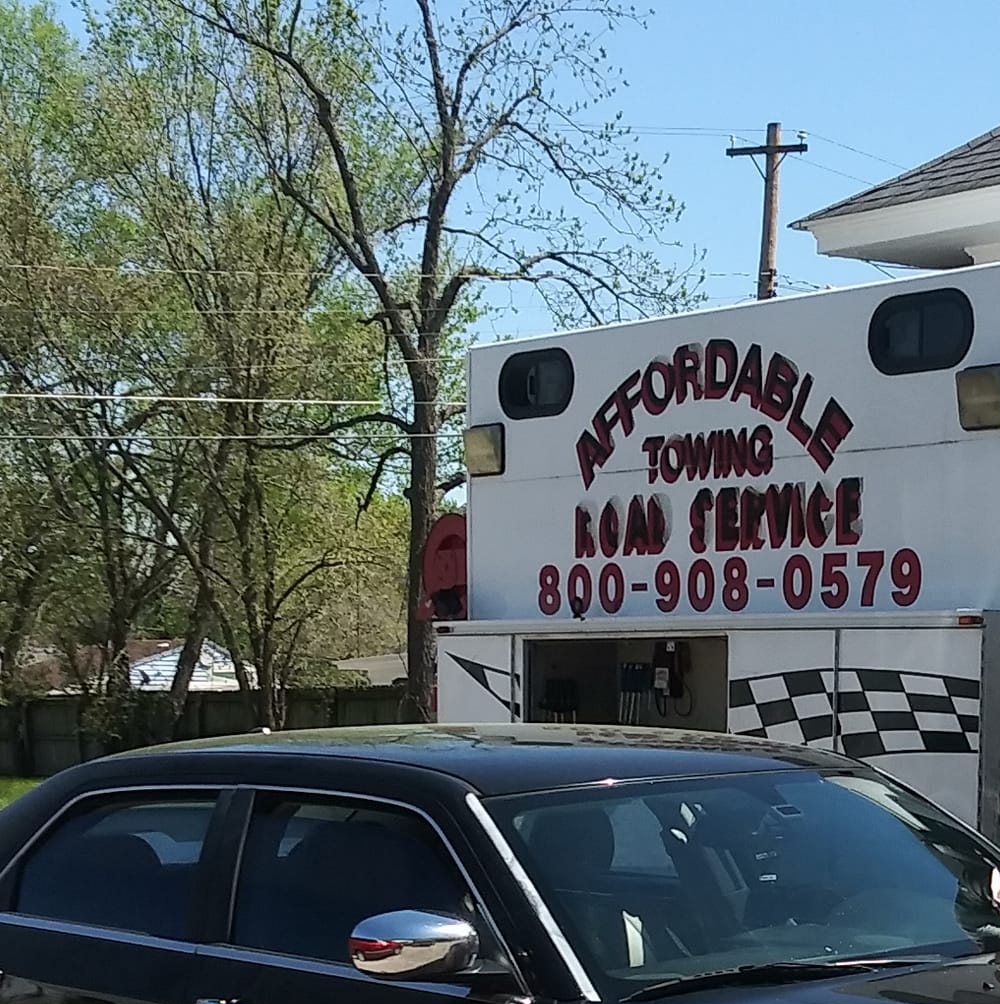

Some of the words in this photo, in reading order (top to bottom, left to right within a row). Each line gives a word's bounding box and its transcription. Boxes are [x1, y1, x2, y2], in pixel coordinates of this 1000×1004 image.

[576, 338, 854, 491] AFFORDABLE
[642, 424, 774, 485] TOWING
[575, 494, 672, 558] ROAD
[689, 477, 864, 554] SERVICE
[538, 548, 923, 616] 800-908-0579
